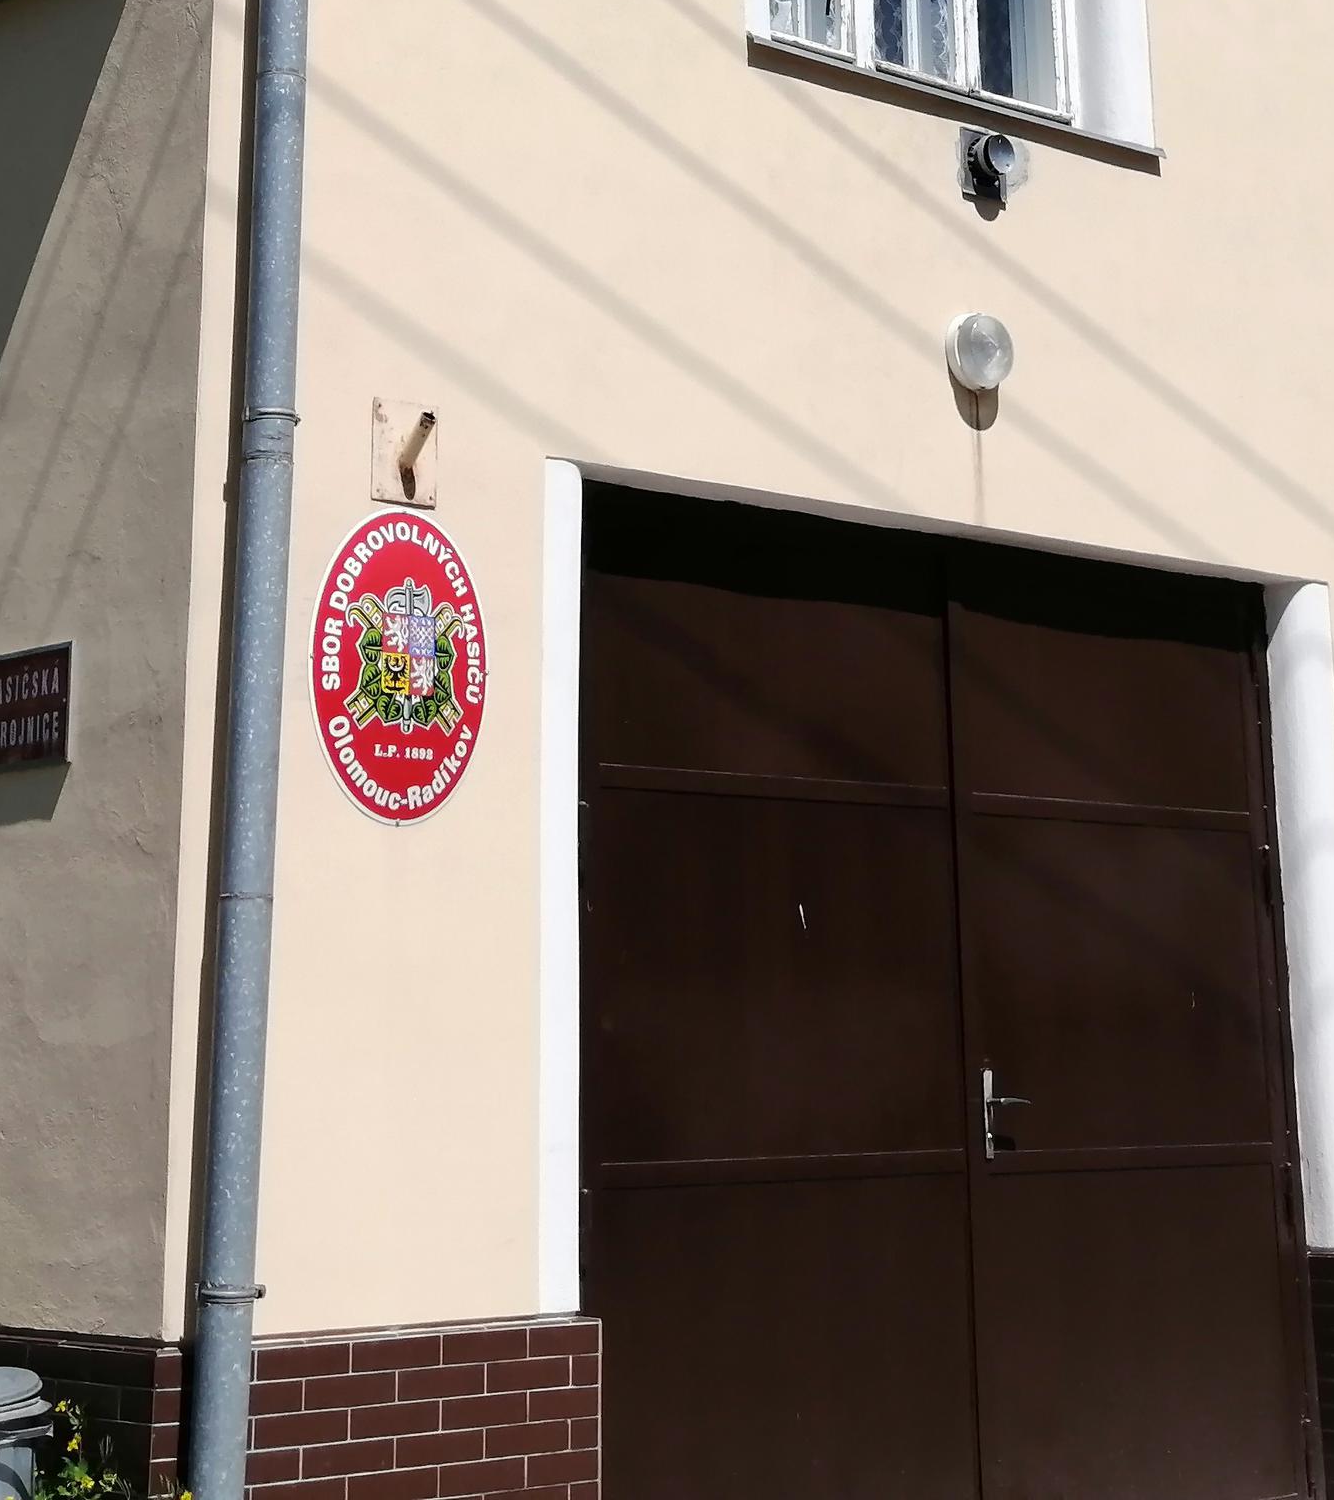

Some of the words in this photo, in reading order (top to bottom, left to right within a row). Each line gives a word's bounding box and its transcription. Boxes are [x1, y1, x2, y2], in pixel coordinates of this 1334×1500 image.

[329, 521, 467, 609] DOBROVOLNÝCH
[321, 619, 344, 691] SBOR
[460, 603, 484, 705] HASIČŮ
[327, 714, 474, 810] Olomouc-Radíkov
[373, 743, 401, 758] L.P.
